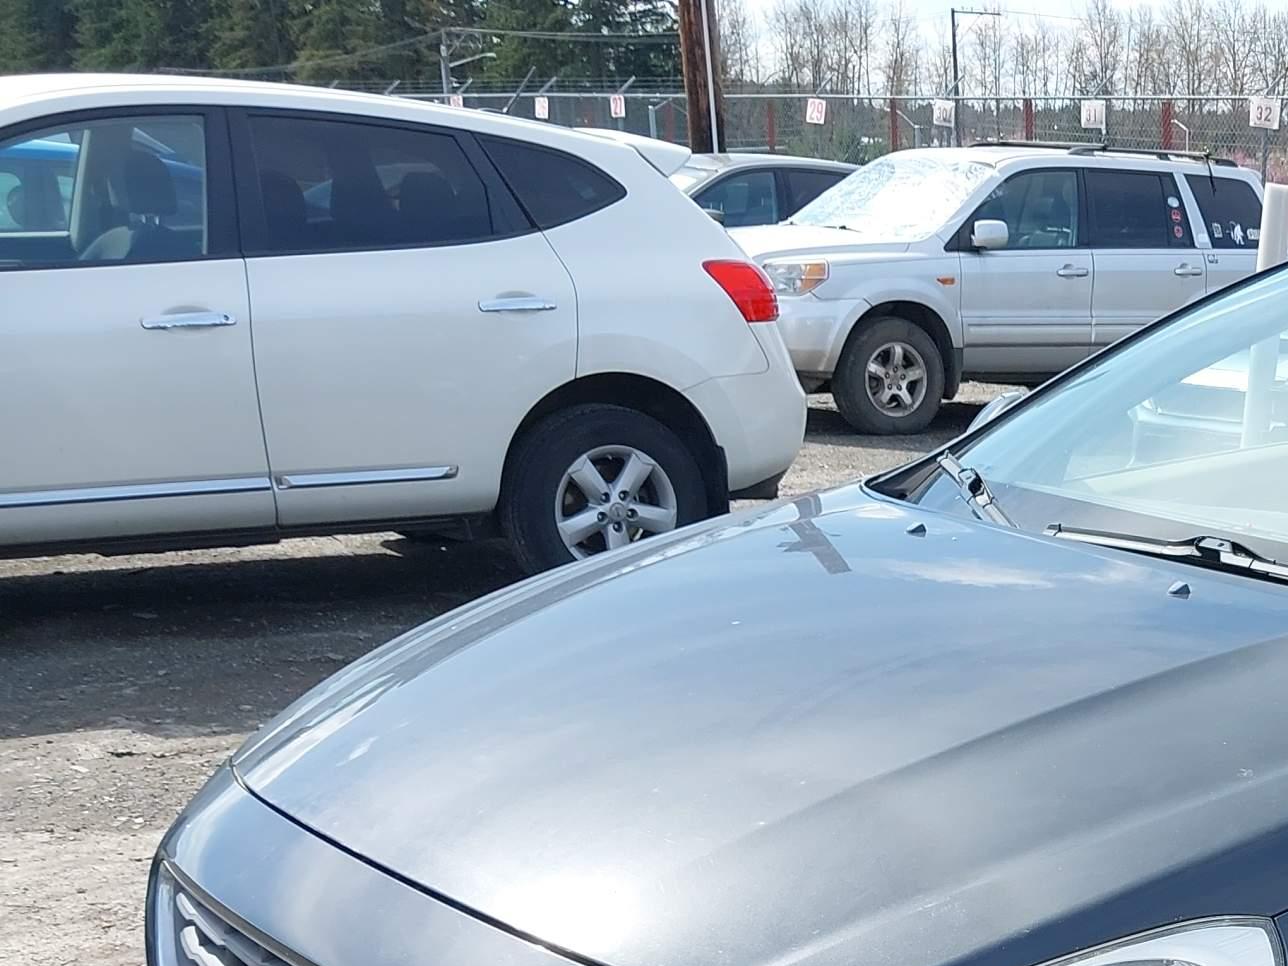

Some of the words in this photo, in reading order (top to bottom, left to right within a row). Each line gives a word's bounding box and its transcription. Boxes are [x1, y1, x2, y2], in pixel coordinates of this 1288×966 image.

[612, 96, 623, 115] 27
[809, 99, 823, 122] 29
[1255, 105, 1272, 122] 32
[1085, 108, 1097, 122] 31
